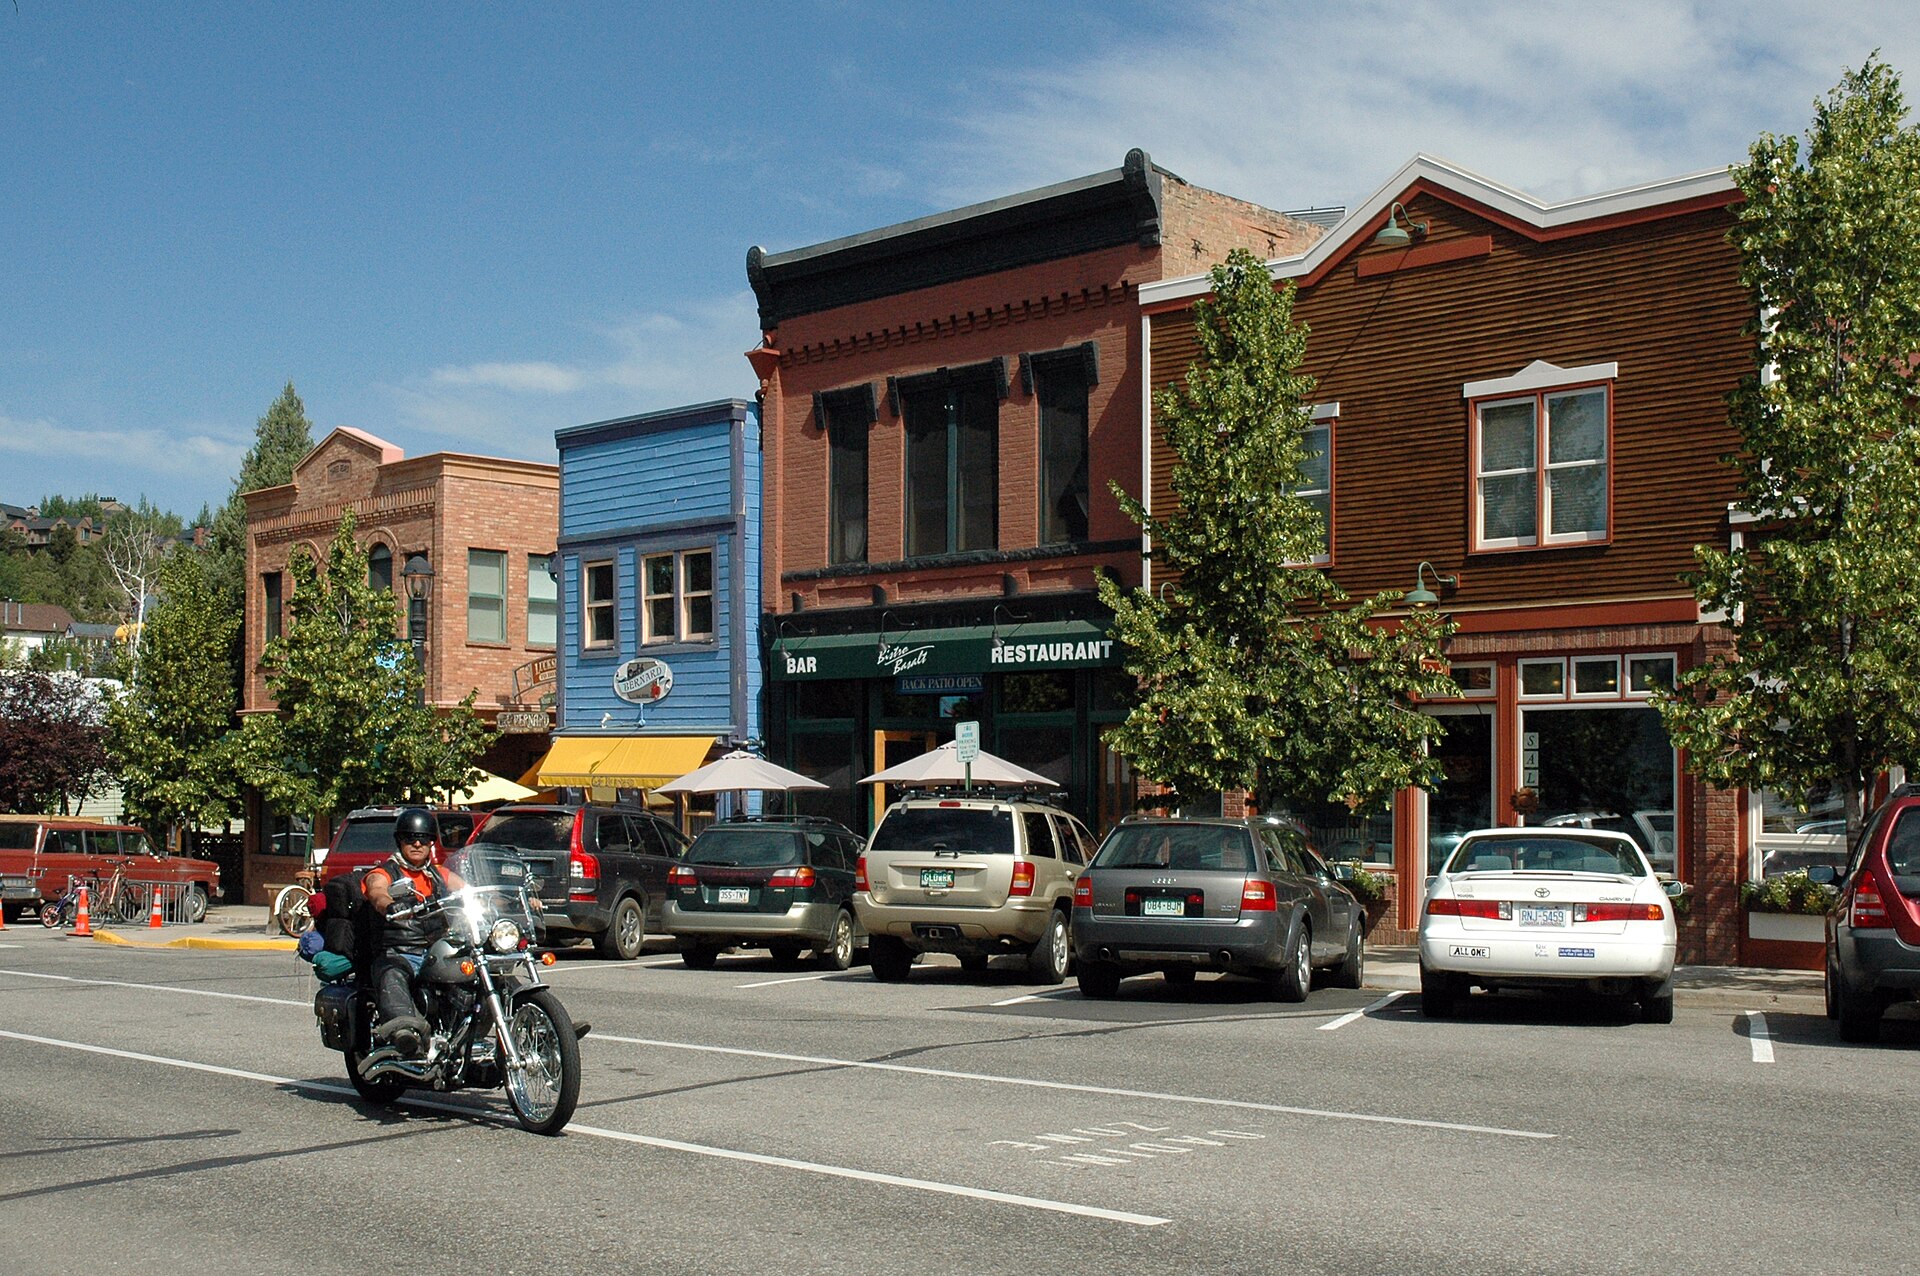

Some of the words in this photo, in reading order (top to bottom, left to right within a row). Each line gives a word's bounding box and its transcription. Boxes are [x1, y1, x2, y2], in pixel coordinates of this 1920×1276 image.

[877, 644, 909, 665] Bistro
[892, 650, 928, 675] Basalt
[991, 640, 1114, 664] RESTAURANT
[786, 656, 817, 674] BAR
[624, 666, 662, 692] BERNARD
[902, 679, 926, 690] BACK
[928, 677, 955, 689] PATIO
[956, 676, 982, 688] OPEN
[1453, 947, 1469, 956] ALL
[1470, 948, 1486, 957] ONE
